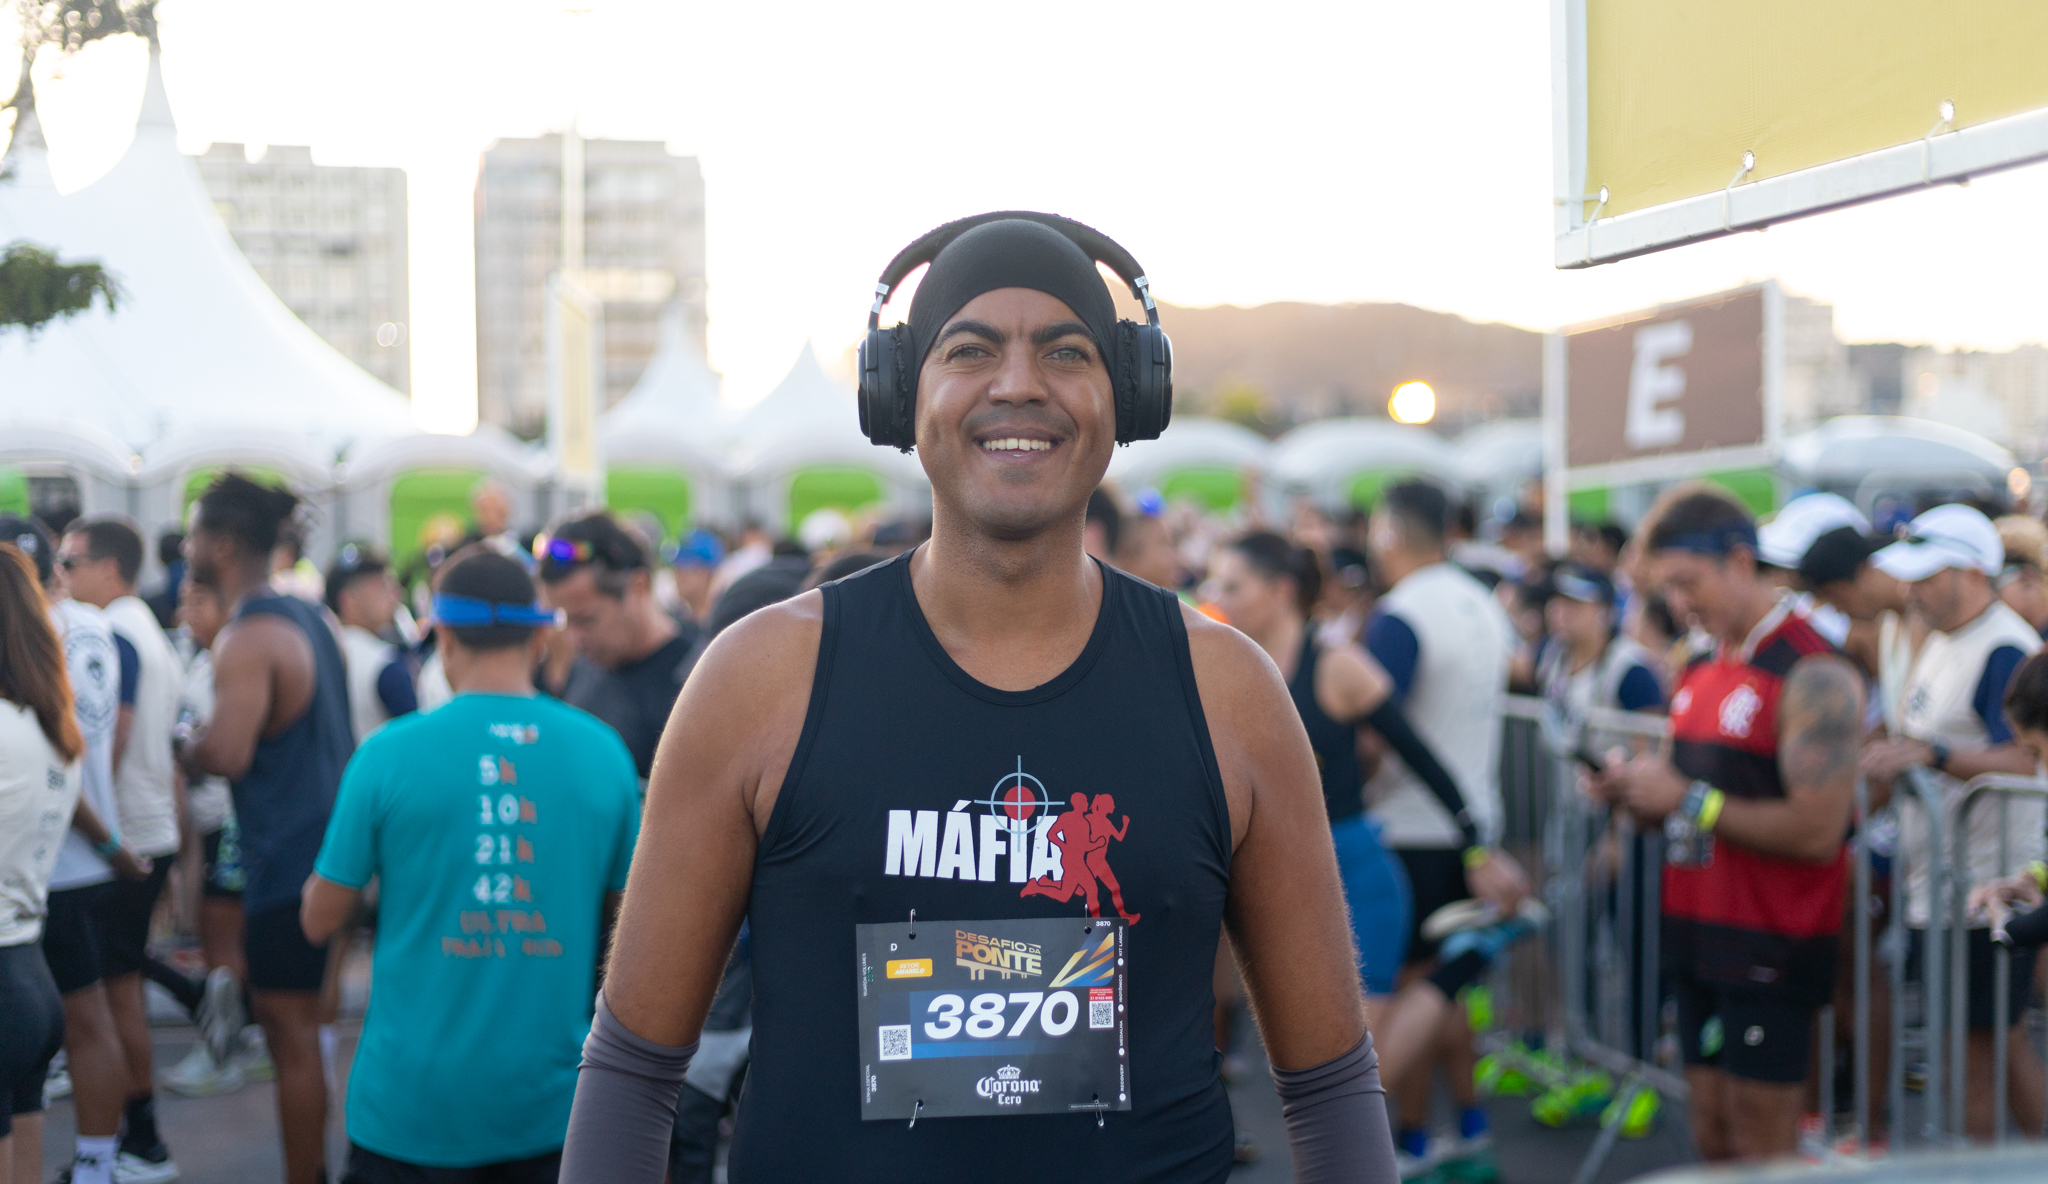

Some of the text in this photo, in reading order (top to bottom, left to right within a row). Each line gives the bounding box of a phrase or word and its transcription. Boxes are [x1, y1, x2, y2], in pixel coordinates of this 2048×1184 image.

[1623, 320, 1694, 450] E
[885, 800, 1064, 883] MÁFIA
[890, 943, 898, 951] D
[955, 929, 1041, 955] DESAFIO DA
[956, 939, 1042, 975] PONTE
[924, 990, 1080, 1040] 3870
[976, 1076, 1040, 1099] Corona
[998, 1094, 1022, 1105] Cero
